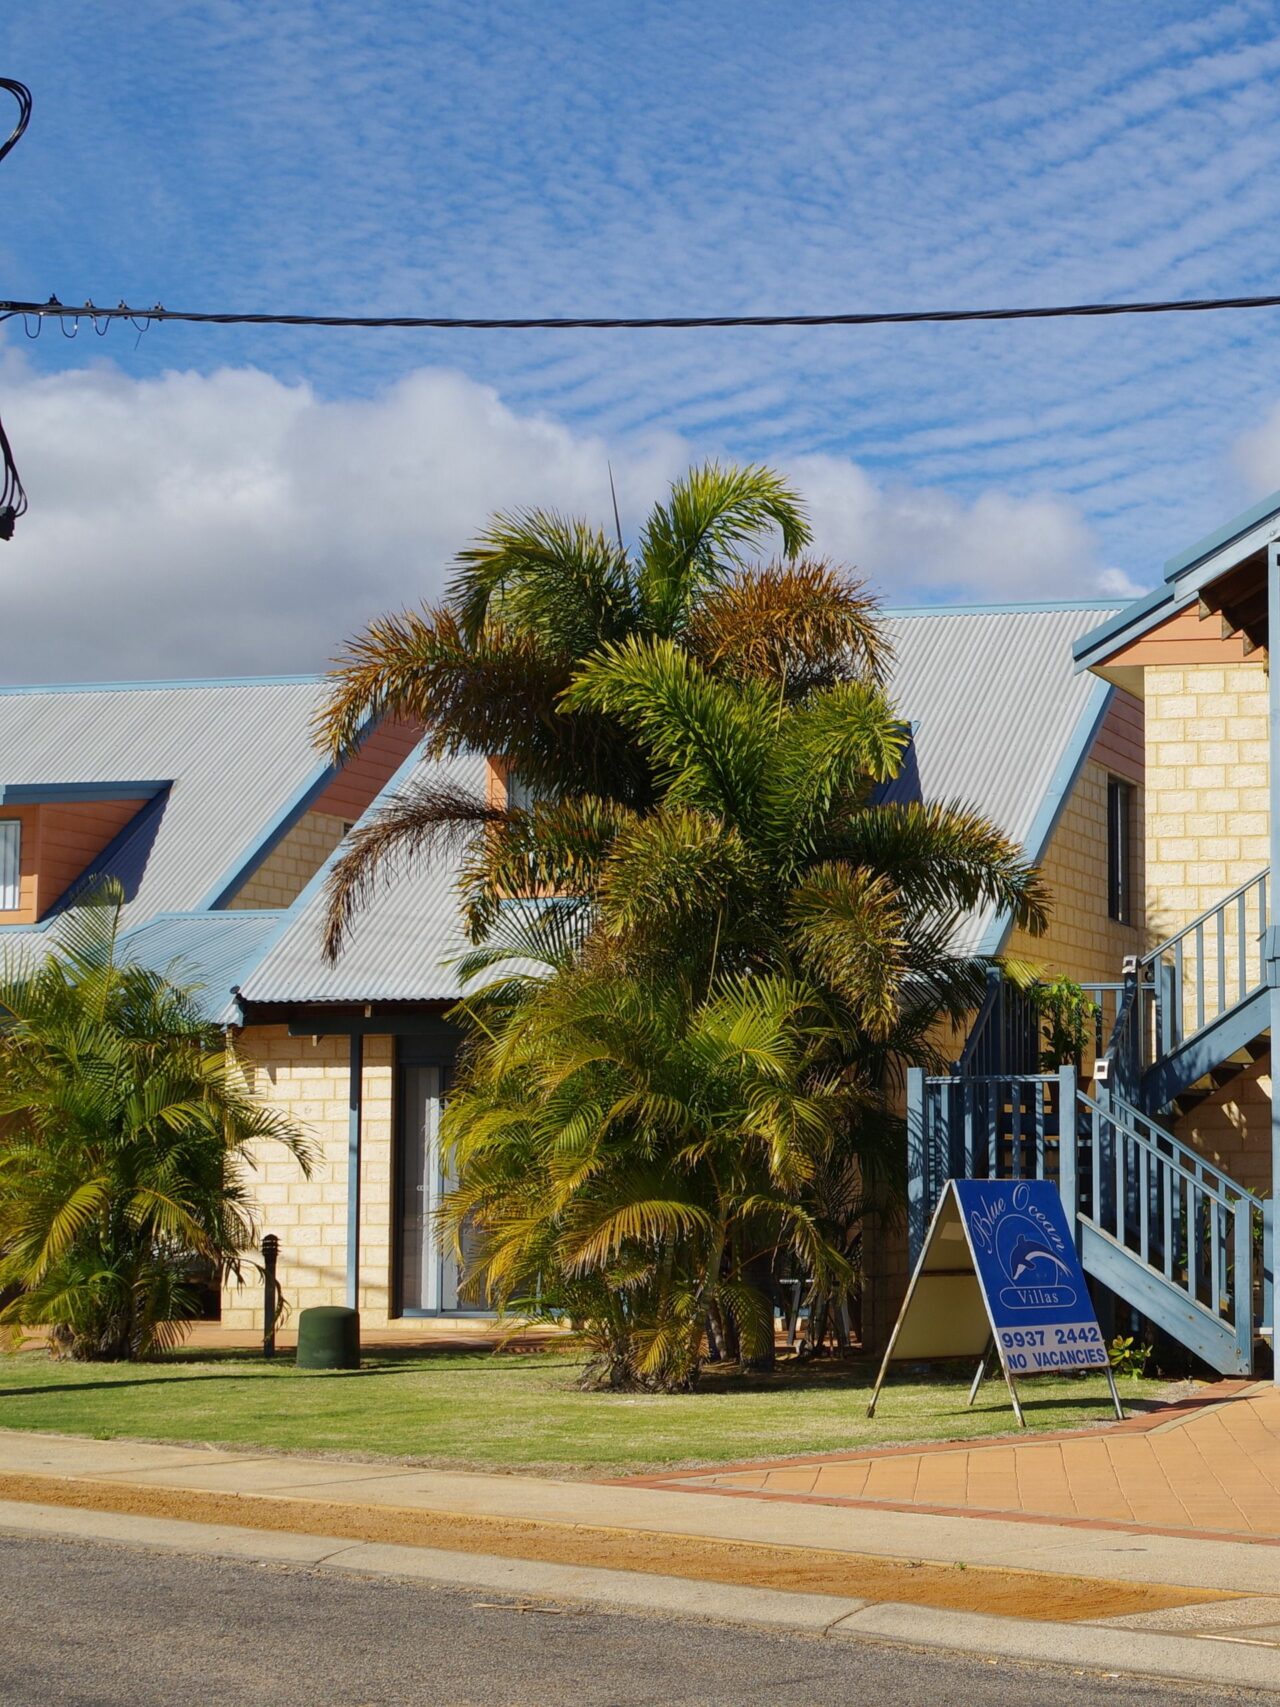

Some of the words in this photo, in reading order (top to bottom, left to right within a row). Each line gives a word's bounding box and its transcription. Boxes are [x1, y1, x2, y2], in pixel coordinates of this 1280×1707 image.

[970, 1196, 1006, 1255] Blue
[1012, 1182, 1065, 1253] Ocean
[1016, 1288, 1059, 1305] Villas
[1002, 1330, 1045, 1349] 9937
[1054, 1327, 1100, 1345] 2442
[1007, 1353, 1028, 1370] NO
[1034, 1348, 1106, 1368] VACANCIES
